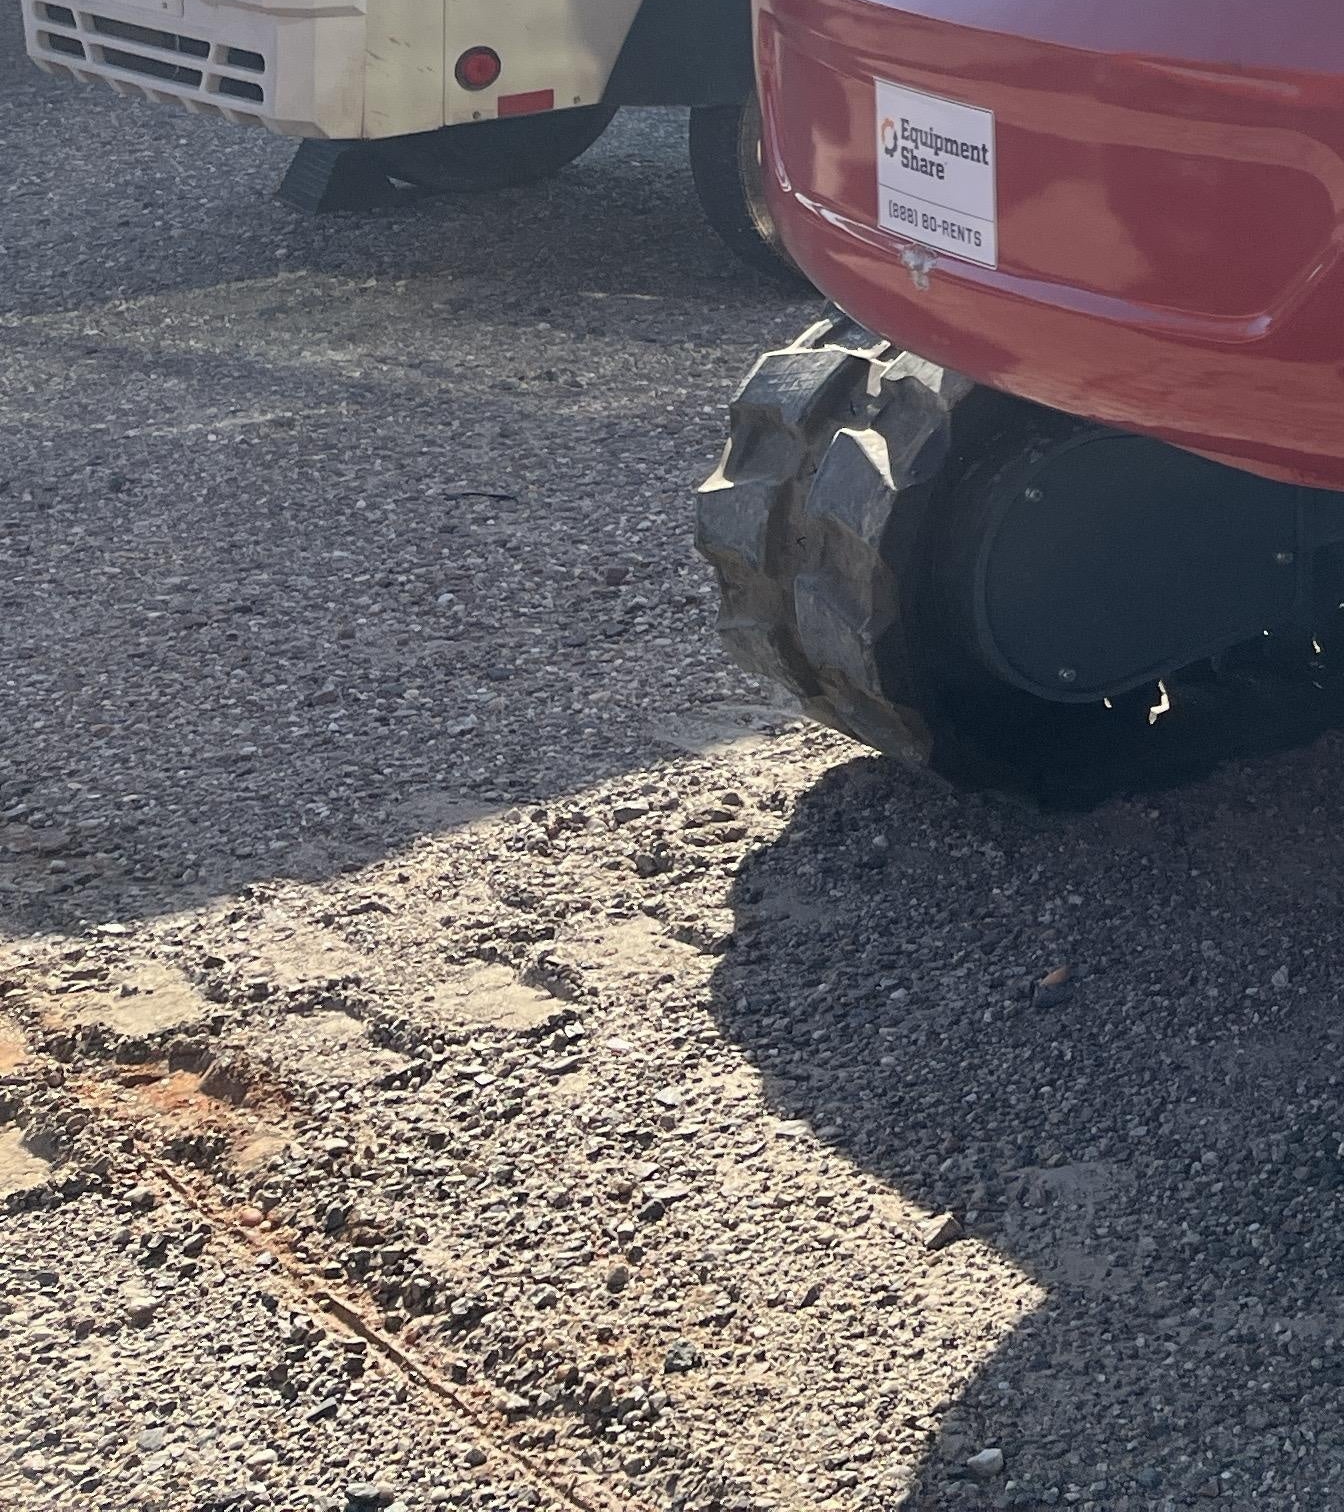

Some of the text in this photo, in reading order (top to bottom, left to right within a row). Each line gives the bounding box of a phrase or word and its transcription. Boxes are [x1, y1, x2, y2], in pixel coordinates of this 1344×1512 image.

[900, 118, 989, 166] Equipment
[900, 145, 945, 180] Share
[888, 199, 983, 247] (888) 80-RENTS
